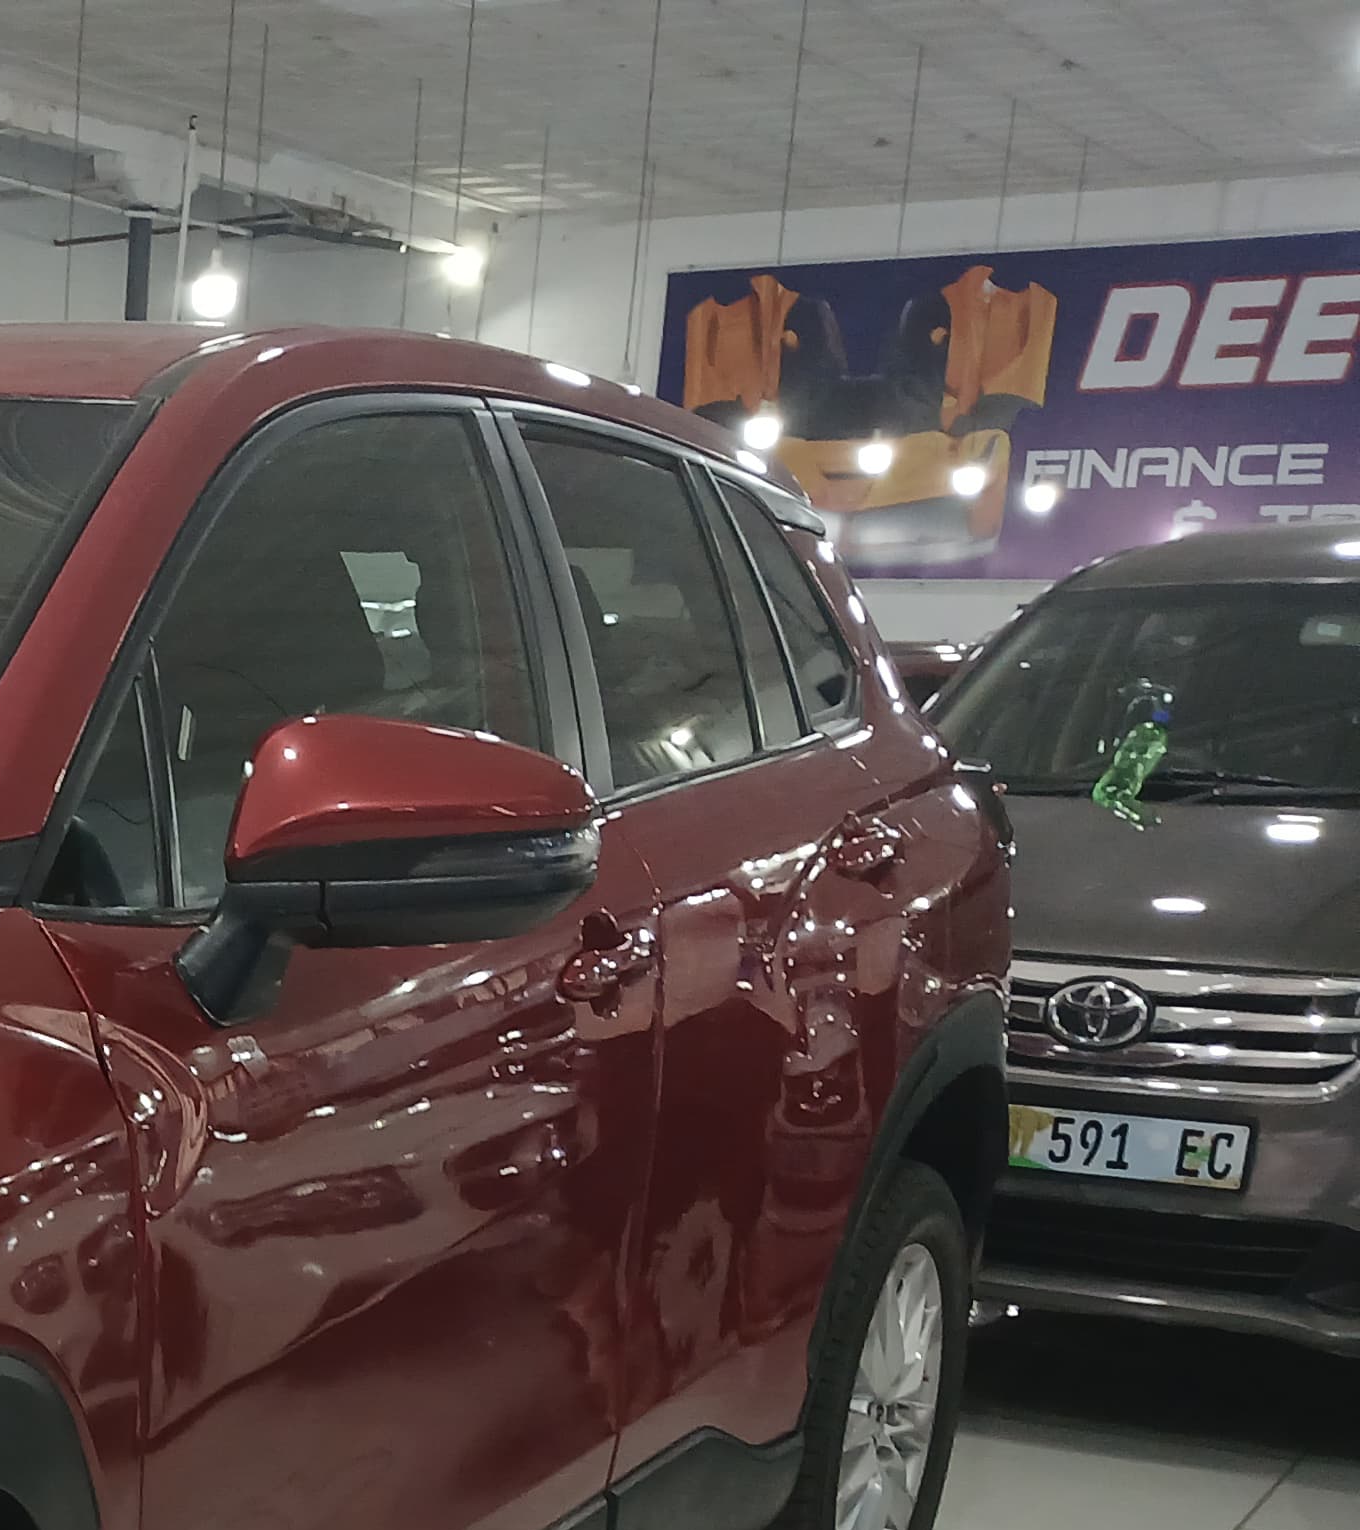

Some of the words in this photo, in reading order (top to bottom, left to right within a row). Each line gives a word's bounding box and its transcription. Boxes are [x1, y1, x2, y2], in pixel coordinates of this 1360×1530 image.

[1024, 443, 1329, 488] FINANCE
[1048, 1116, 1129, 1170] 591
[1175, 1128, 1234, 1180] EC
